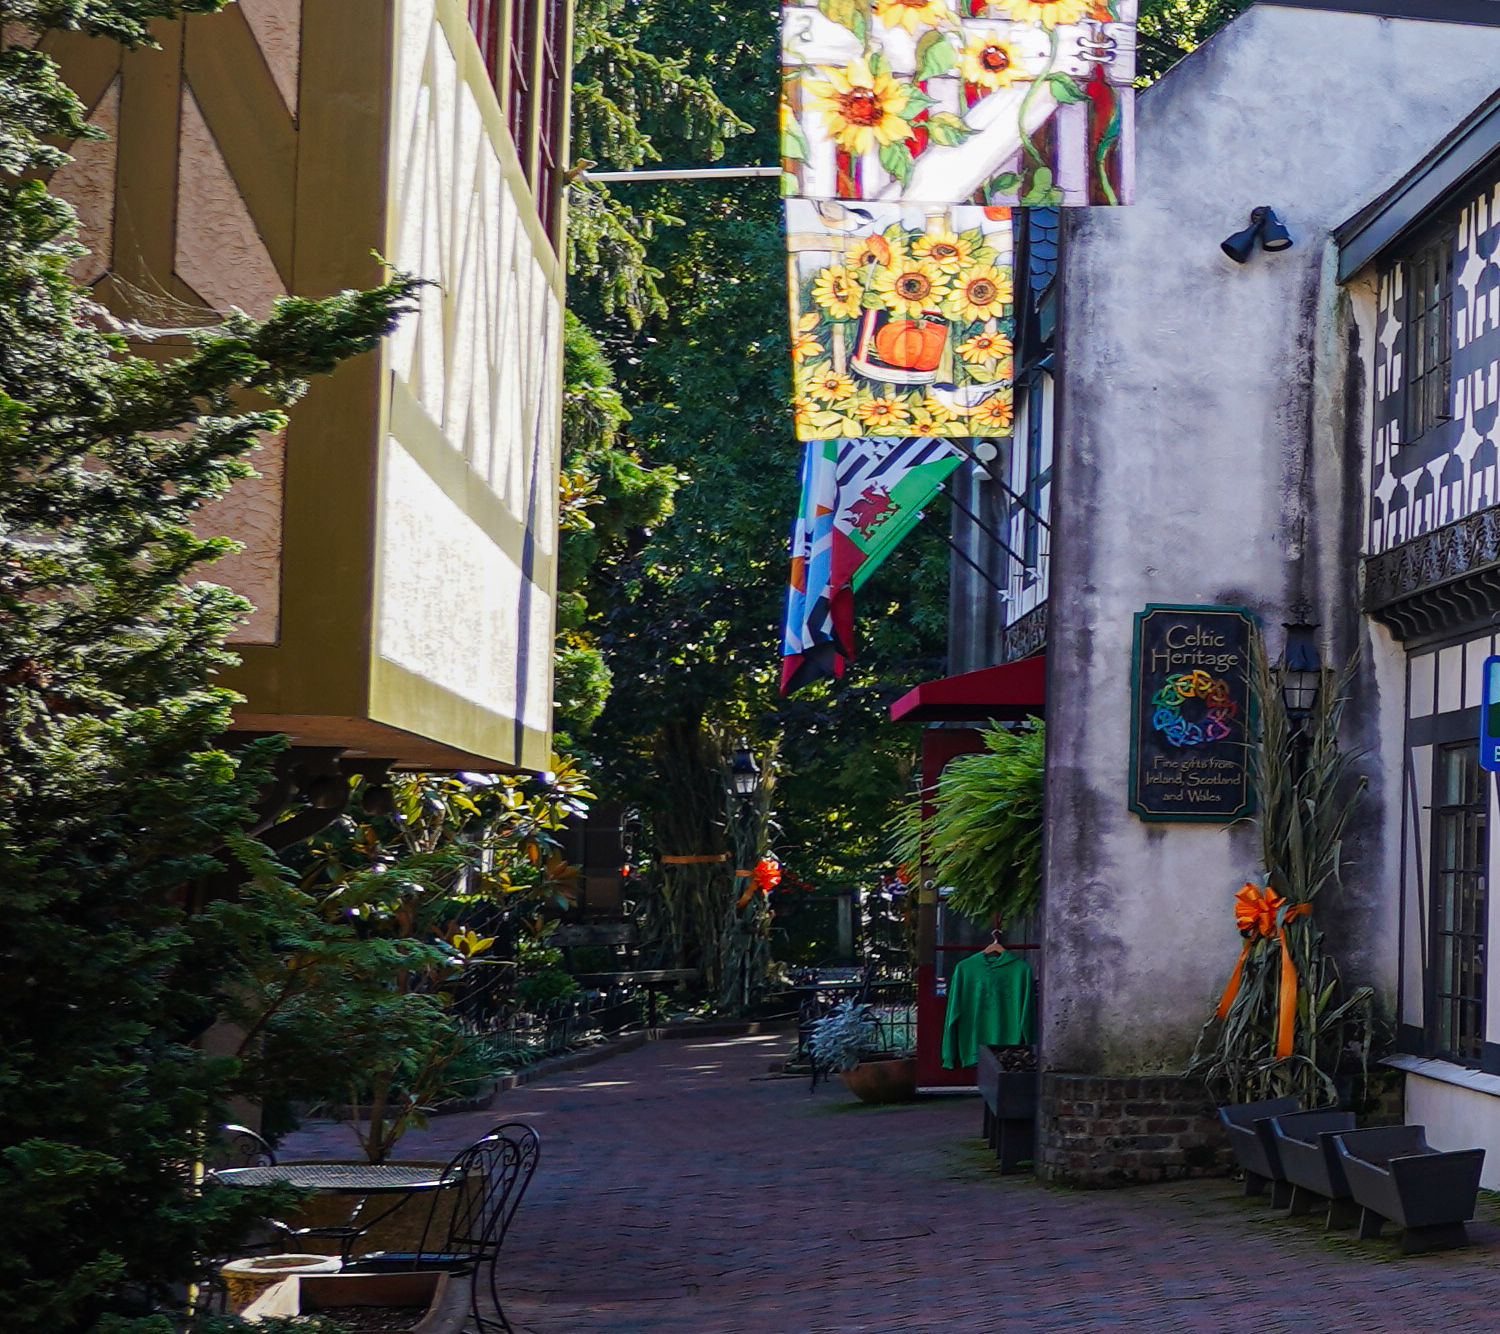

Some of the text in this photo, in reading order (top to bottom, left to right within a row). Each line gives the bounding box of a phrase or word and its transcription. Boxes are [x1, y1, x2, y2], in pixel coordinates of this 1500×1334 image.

[1166, 624, 1225, 649] Celtic
[1151, 648, 1239, 673] Heritage
[1154, 755, 1178, 769] Fine
[1146, 772, 1240, 786] Ireland, Scotland
[1162, 789, 1222, 802] and Wales
